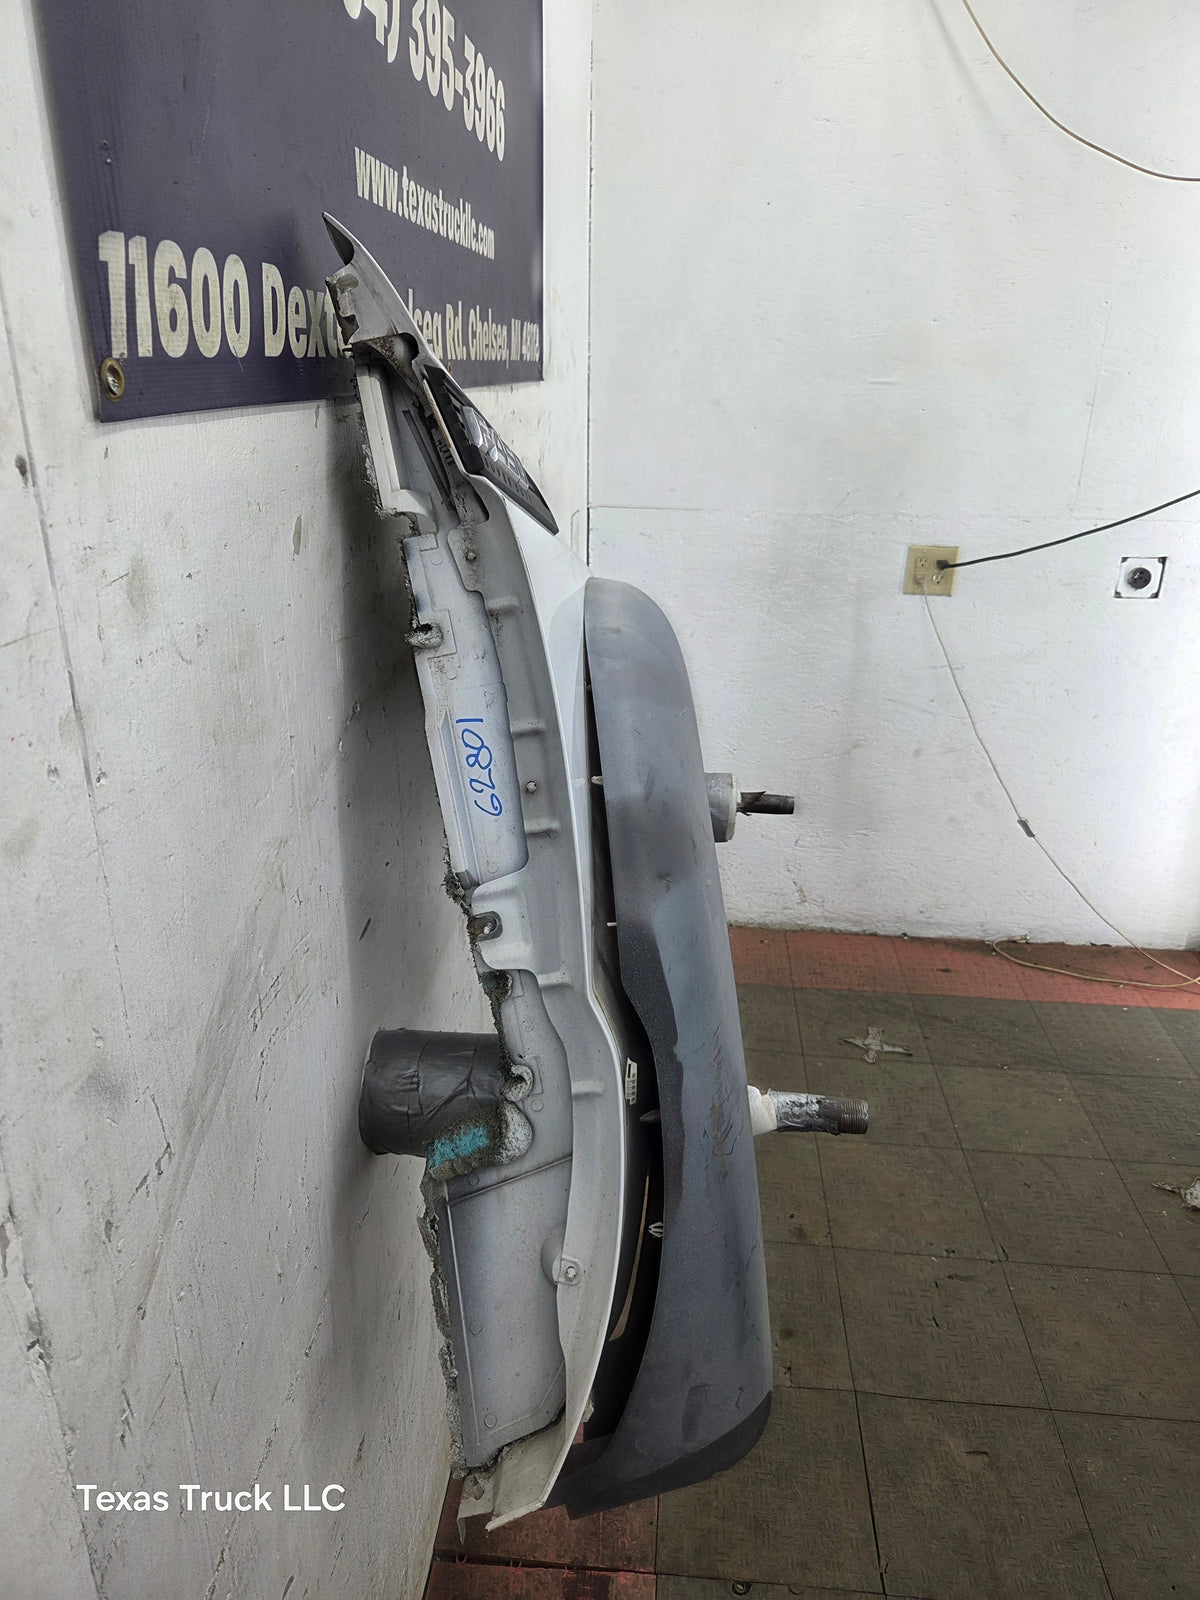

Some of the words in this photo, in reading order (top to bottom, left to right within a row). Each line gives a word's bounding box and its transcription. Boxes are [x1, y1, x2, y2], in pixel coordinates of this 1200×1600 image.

[409, 0, 505, 162] 395-3966
[354, 146, 495, 260] www.texastruckllc.com
[98, 230, 251, 358] 11600
[446, 301, 467, 361] Rd.
[468, 305, 509, 370] Chelsea,
[456, 718, 503, 816] 62801
